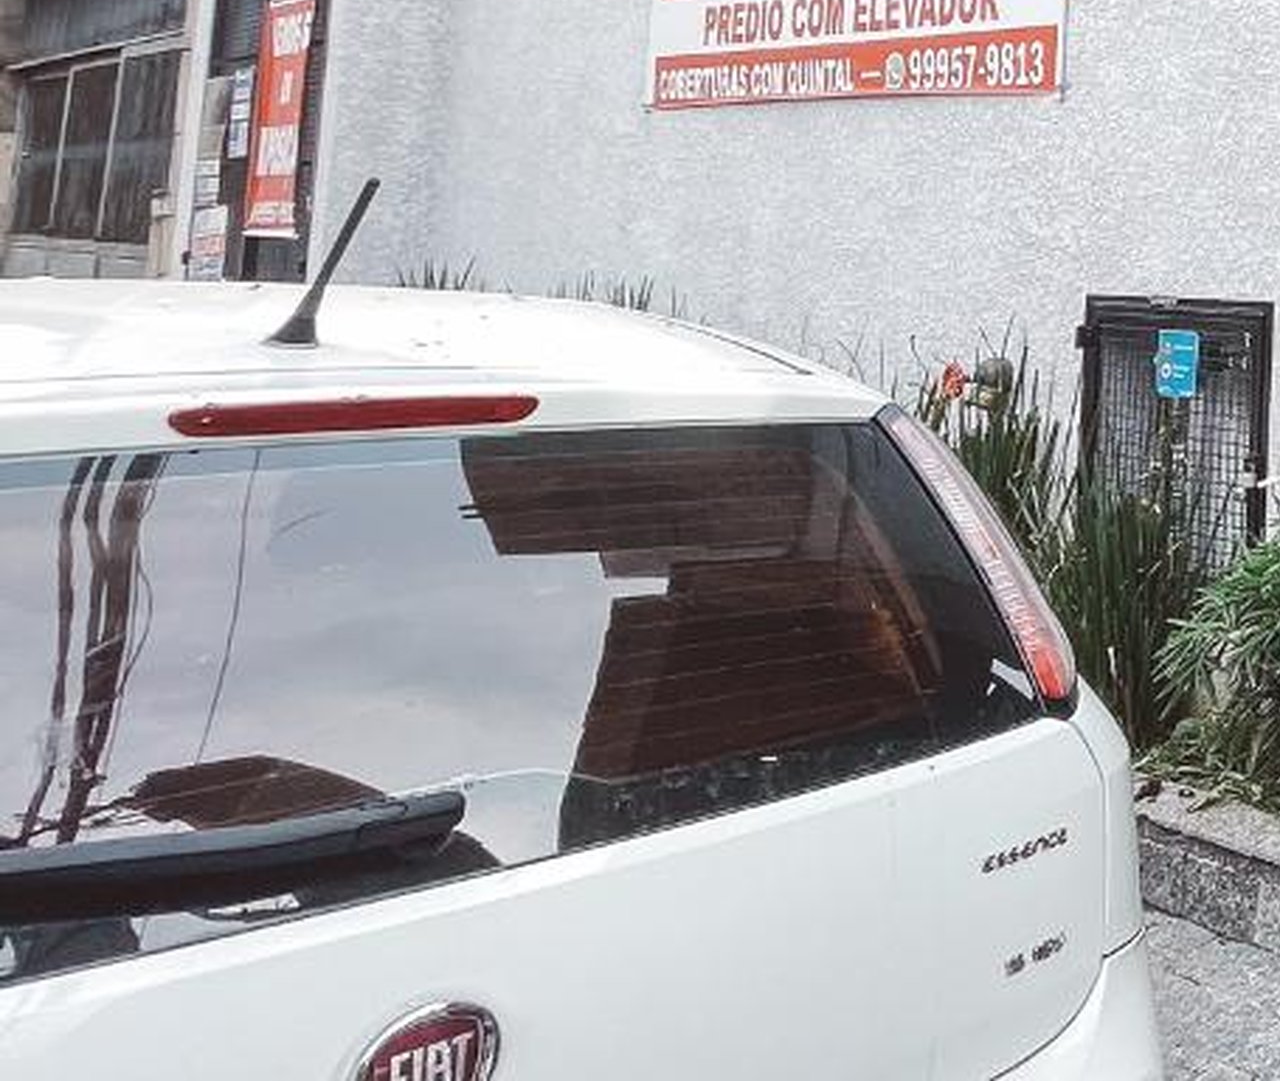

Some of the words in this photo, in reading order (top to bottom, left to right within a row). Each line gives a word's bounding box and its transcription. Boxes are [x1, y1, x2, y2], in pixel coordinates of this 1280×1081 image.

[659, 65, 750, 100] COBERTURAS
[751, 62, 786, 97] COM
[909, 40, 1045, 90] 99957-9813
